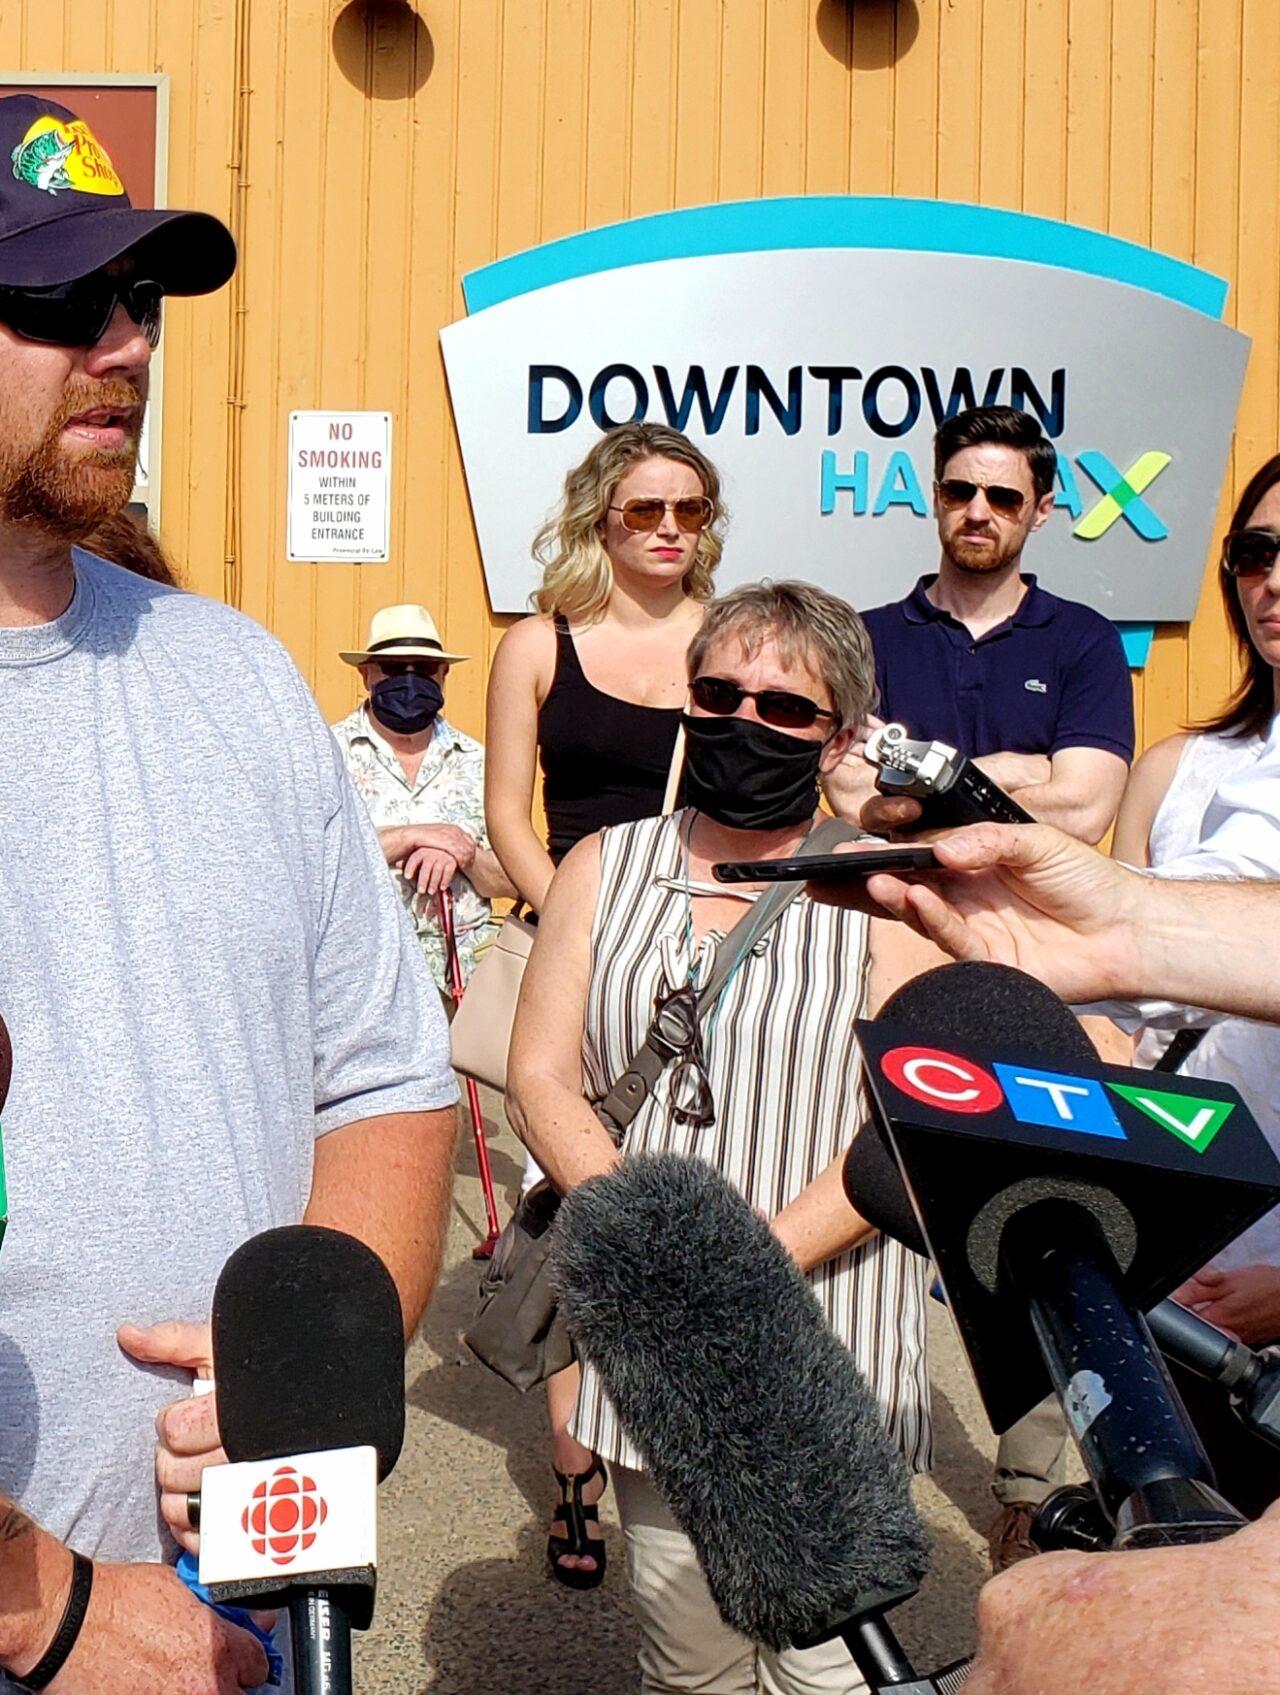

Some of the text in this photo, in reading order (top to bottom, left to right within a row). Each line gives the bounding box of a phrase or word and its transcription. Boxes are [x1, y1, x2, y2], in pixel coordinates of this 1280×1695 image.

[527, 363, 1067, 438] DOWNTOWN
[329, 423, 353, 440] NO
[298, 450, 382, 469] SMOKING
[319, 476, 356, 488] WITHIN
[304, 493, 371, 506] 5 METERS OF
[820, 449, 1173, 541] HAAX
[313, 511, 361, 523] BUILDING
[312, 528, 365, 541] ENTRANCE
[897, 1055, 1219, 1143] CTV
